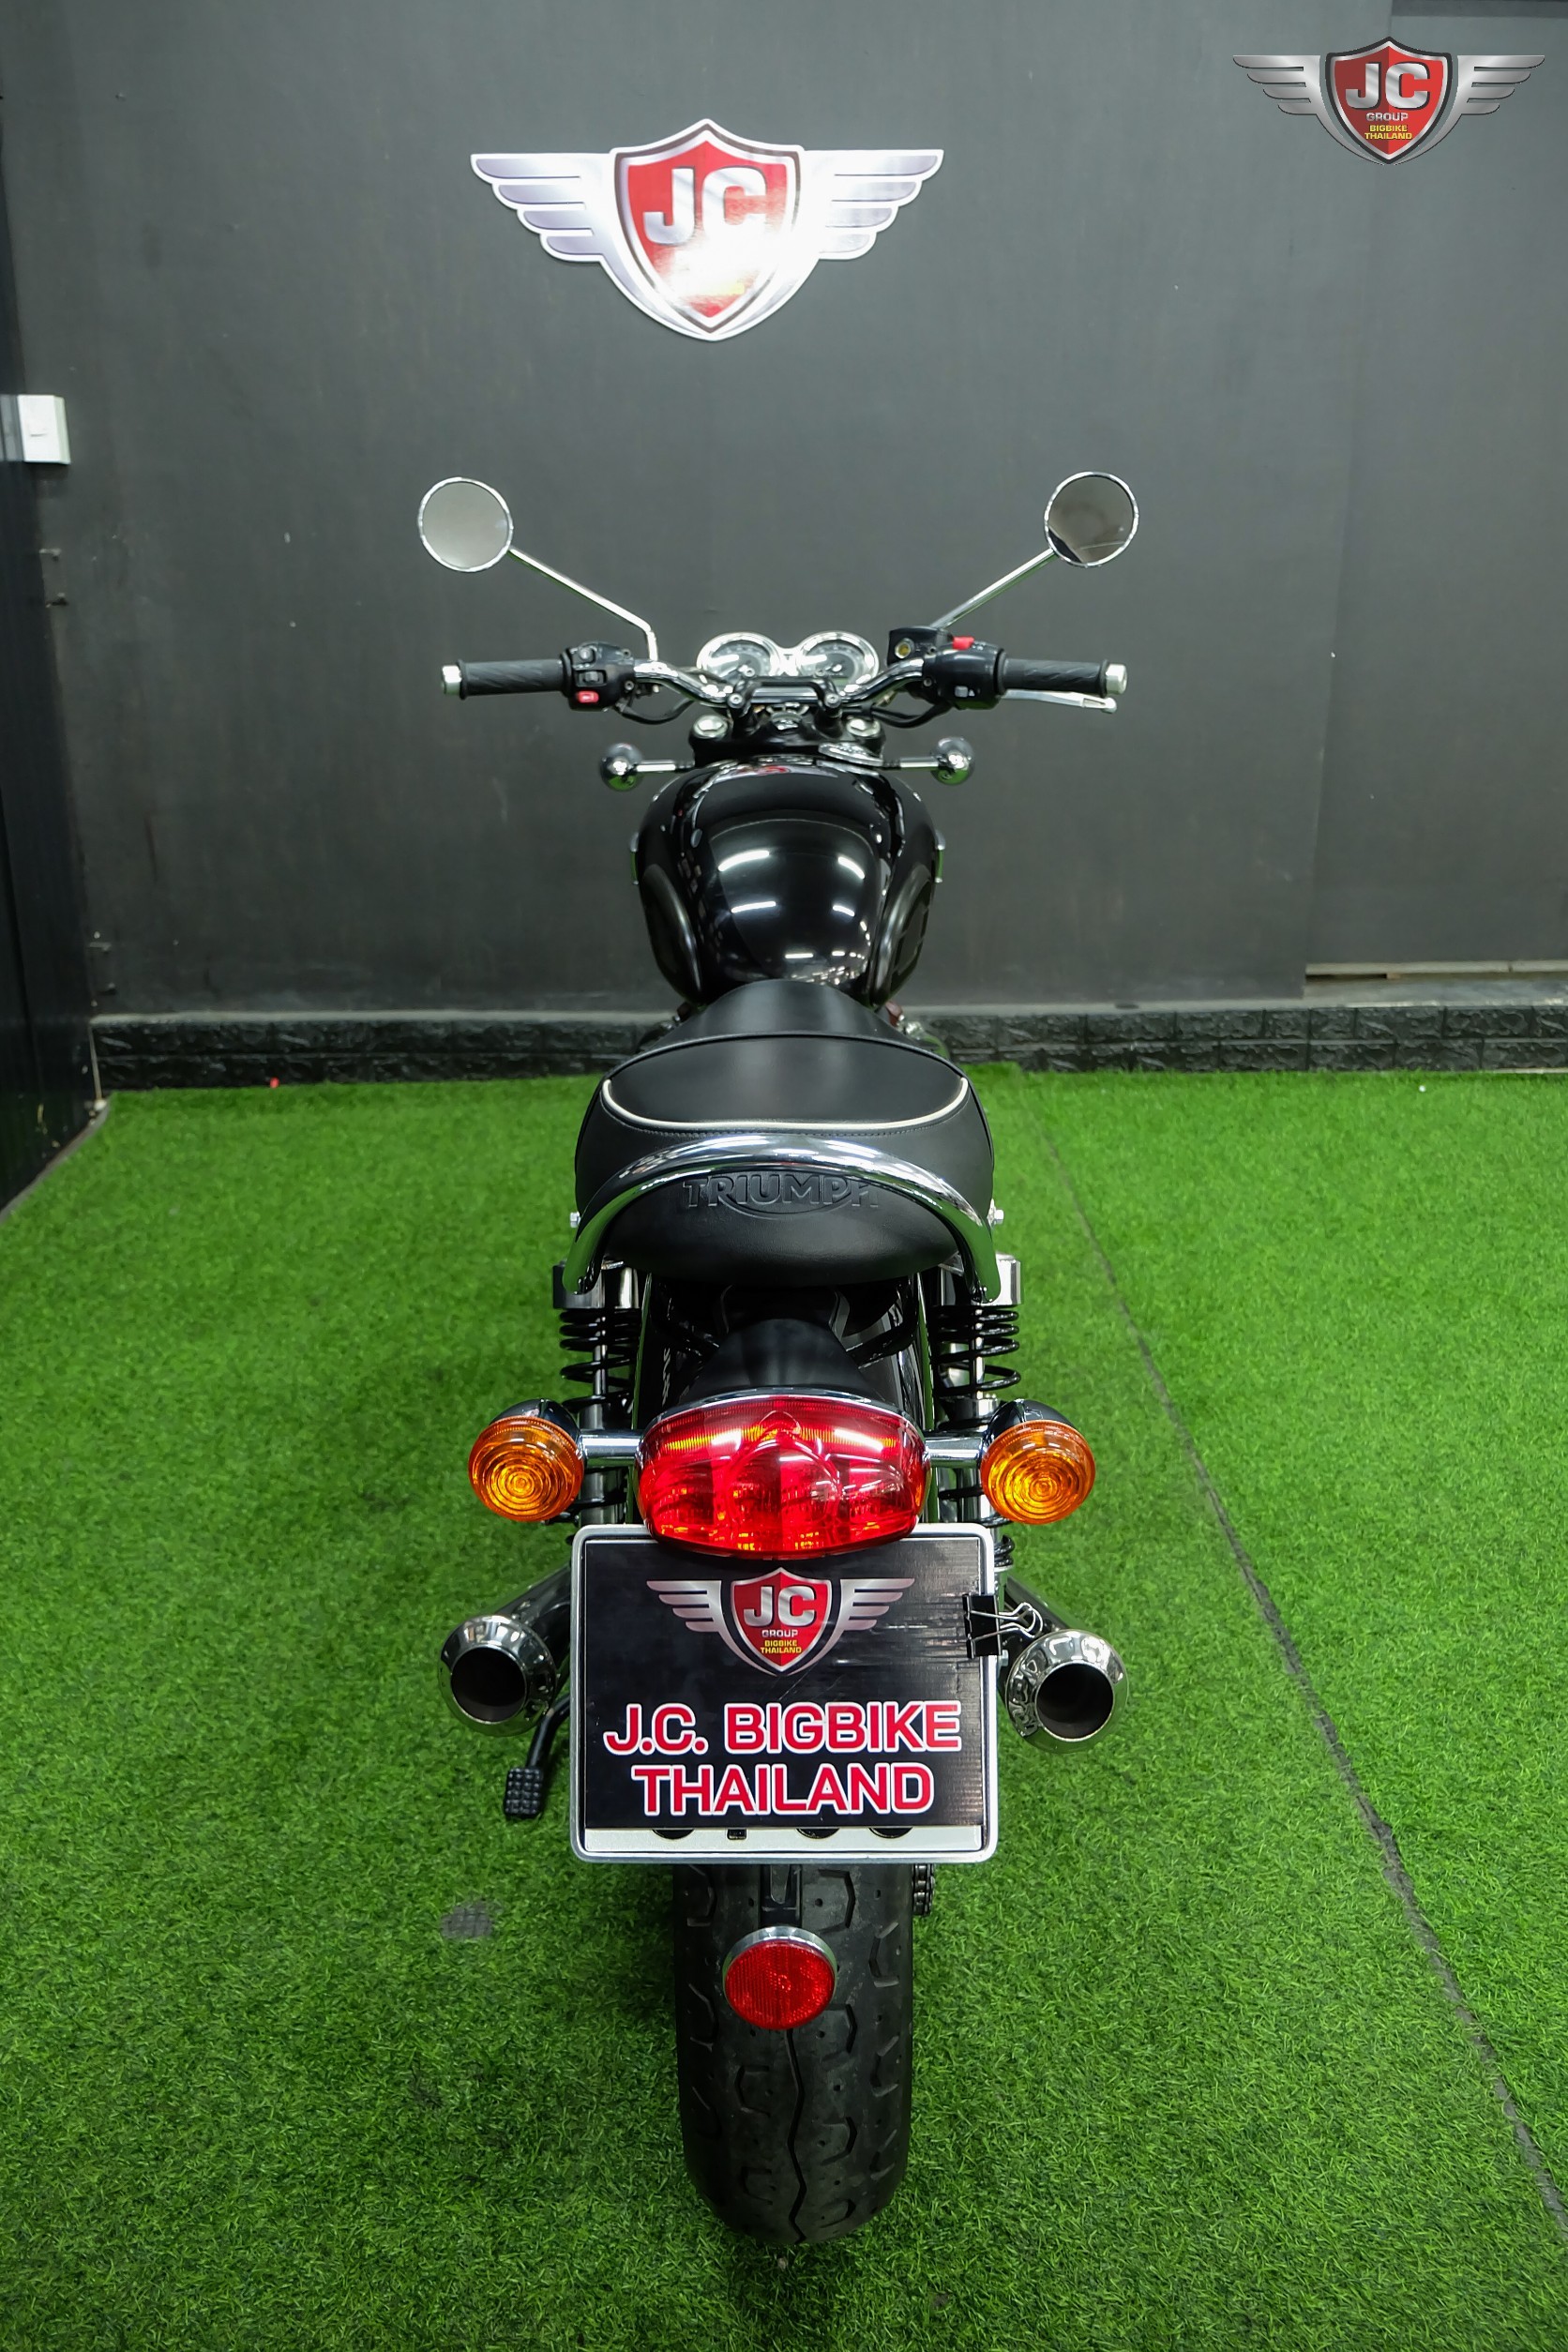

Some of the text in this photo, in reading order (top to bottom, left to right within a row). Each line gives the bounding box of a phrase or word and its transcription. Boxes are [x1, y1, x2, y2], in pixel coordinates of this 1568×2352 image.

[642, 165, 767, 246] JC
[743, 1585, 816, 1627] JC
[760, 1646, 802, 1654] THAILAND
[761, 1629, 798, 1637] GROUP
[603, 1700, 962, 1755] J.C. BIGBIKE
[631, 1761, 935, 1816] THAILAND
